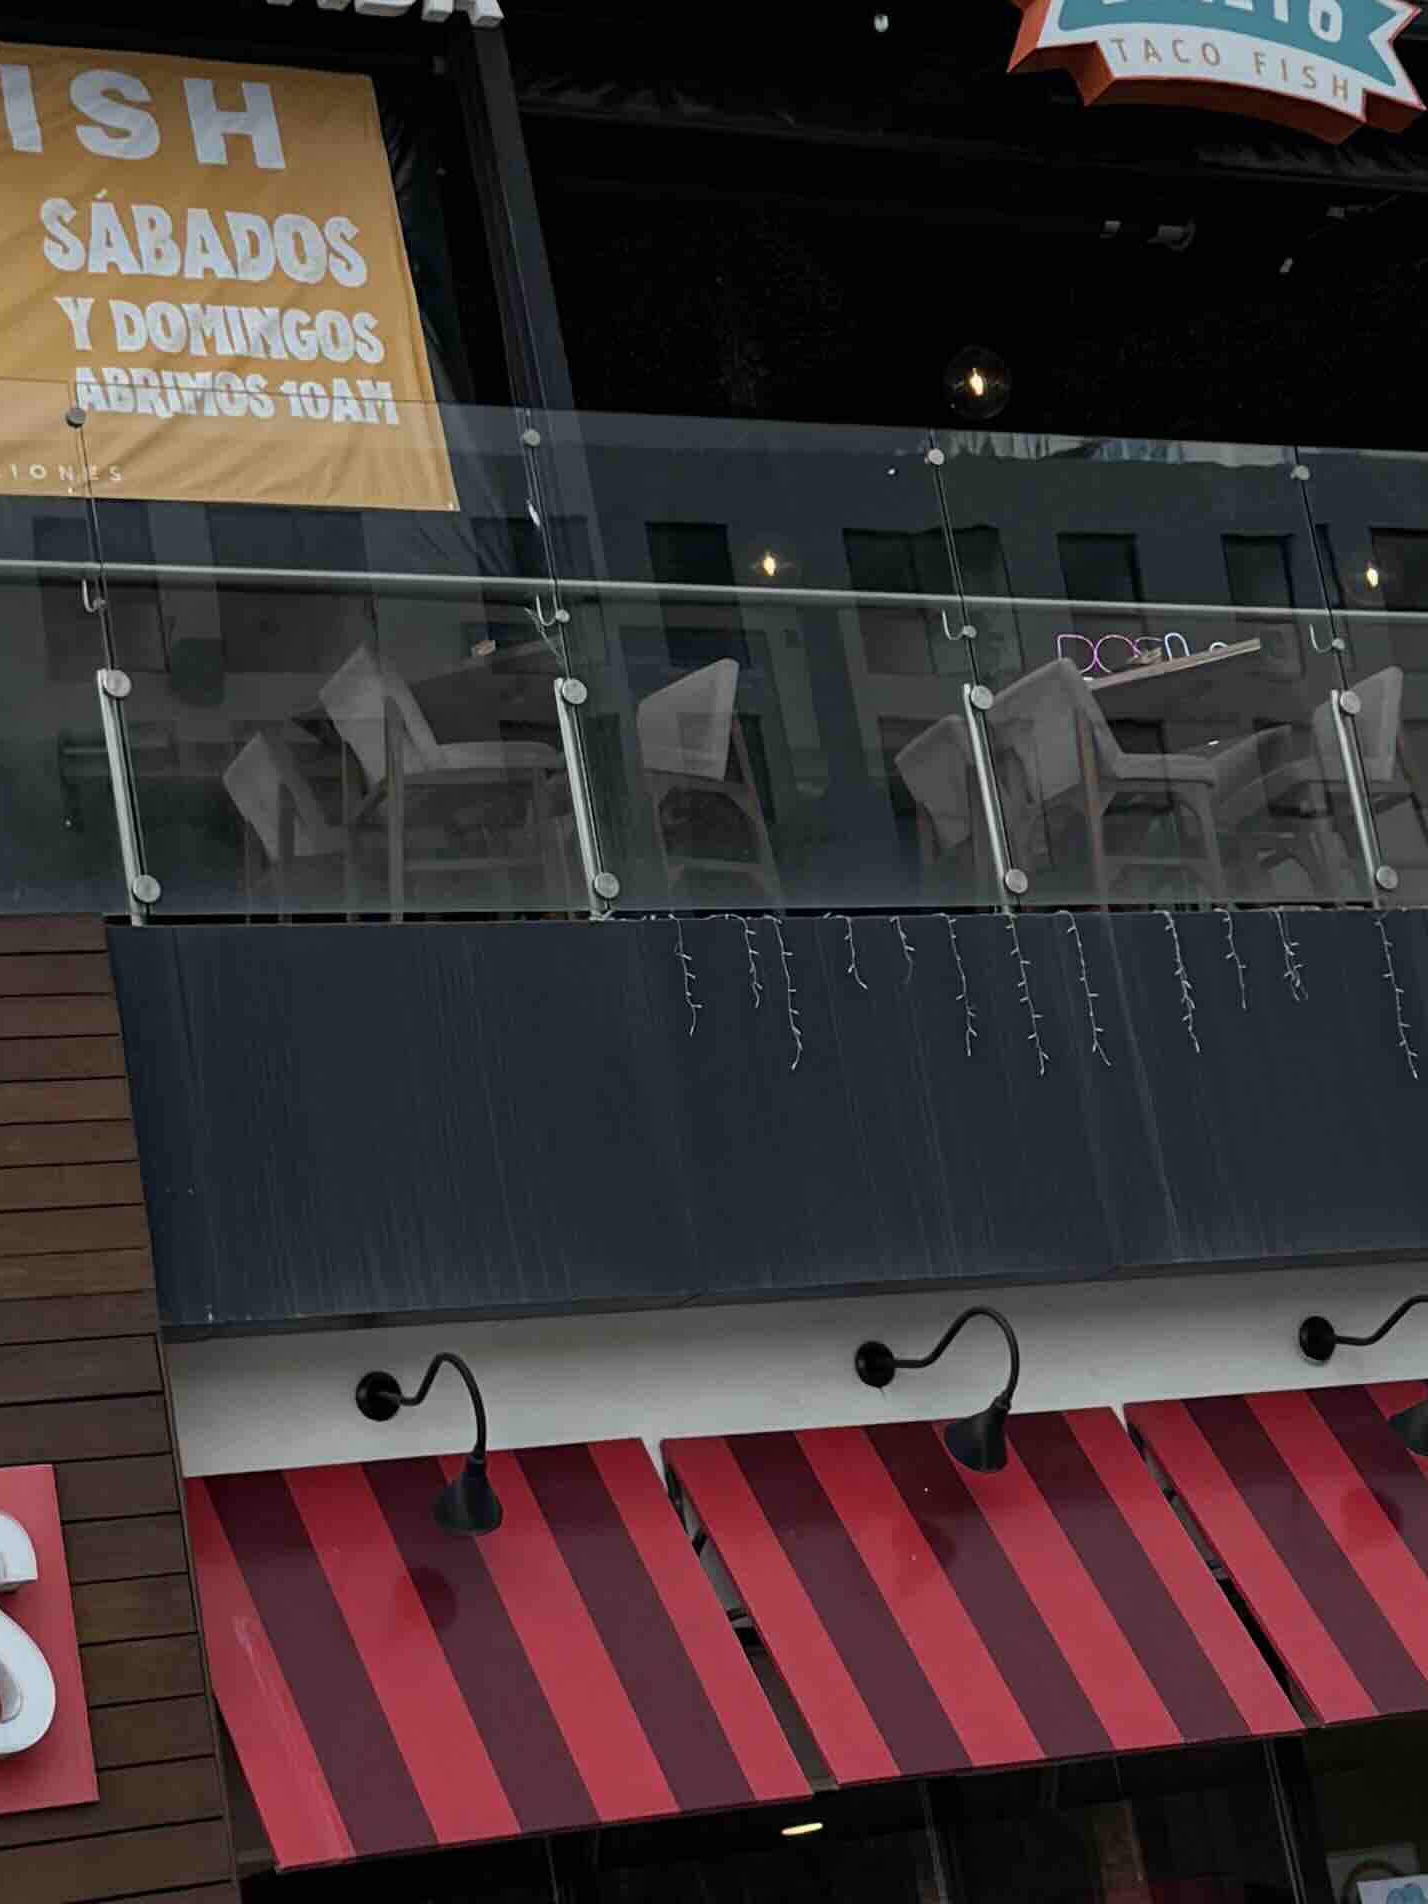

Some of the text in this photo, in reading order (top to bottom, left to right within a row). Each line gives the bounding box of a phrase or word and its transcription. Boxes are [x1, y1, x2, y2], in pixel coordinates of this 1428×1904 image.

[1114, 38, 1350, 101] TACO FISH
[40, 188, 368, 288] SÁBADOS
[54, 296, 385, 364] Y DOMINGOS
[75, 367, 400, 425] ABRIMOS 10AM
